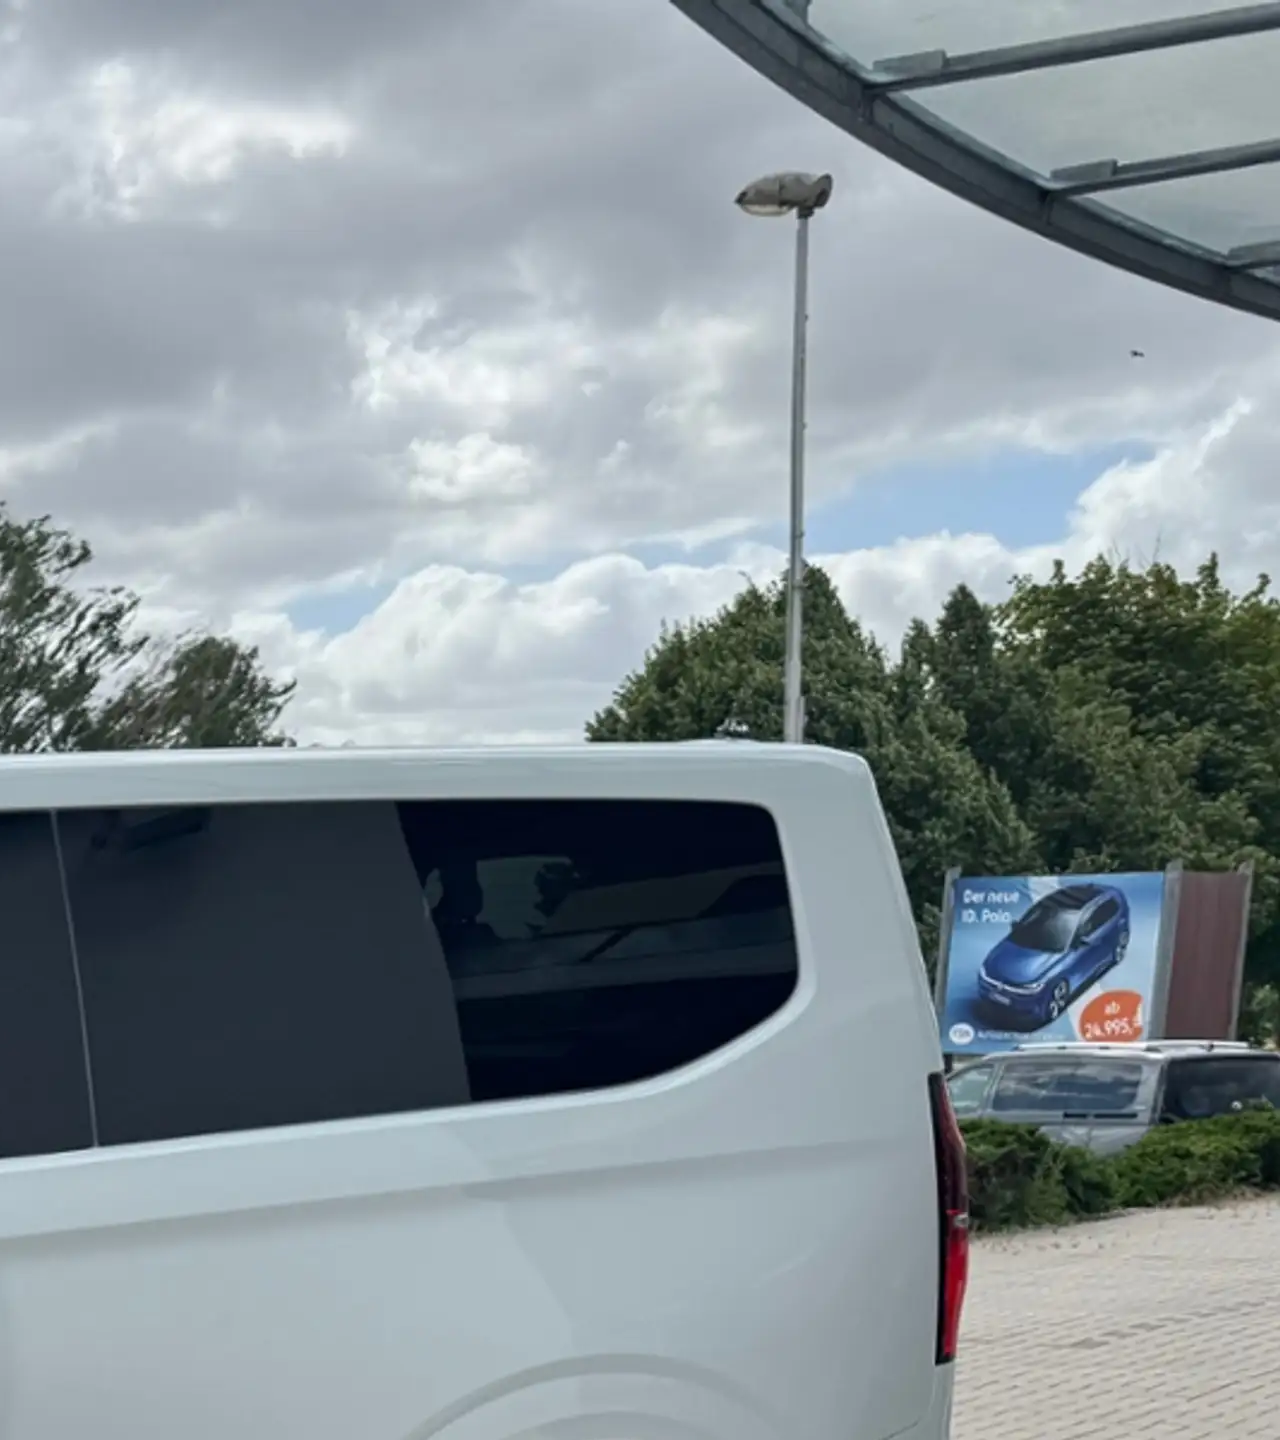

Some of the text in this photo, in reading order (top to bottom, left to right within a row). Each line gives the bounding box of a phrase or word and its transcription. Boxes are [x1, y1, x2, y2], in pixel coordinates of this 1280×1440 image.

[963, 889, 1020, 905] Der neue
[962, 907, 1012, 923] ID. Polo
[1104, 1000, 1121, 1016] ab
